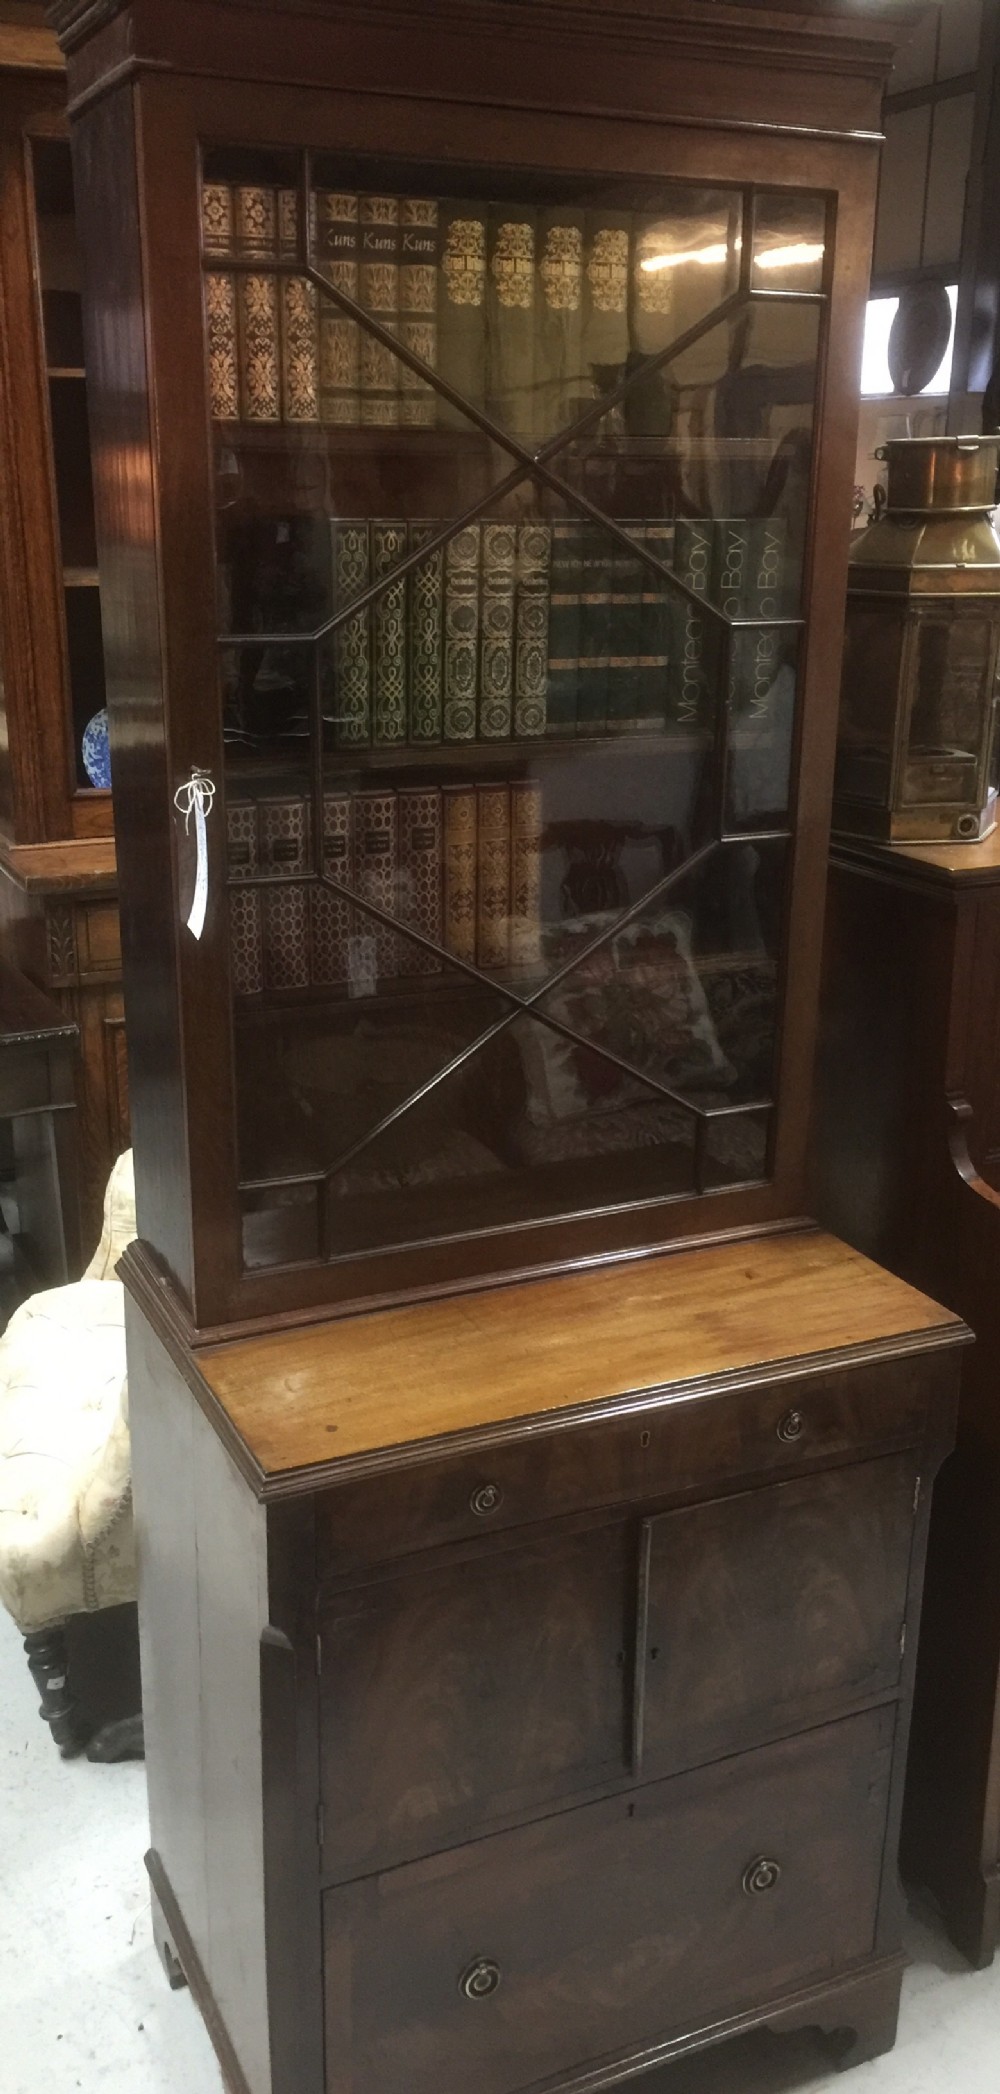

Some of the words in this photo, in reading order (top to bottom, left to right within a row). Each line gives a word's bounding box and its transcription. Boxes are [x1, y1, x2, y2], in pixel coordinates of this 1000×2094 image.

[362, 231, 397, 252] Kuns
[402, 233, 437, 253] Kuns
[685, 531, 712, 590] Bay
[720, 530, 748, 590] Bay
[757, 531, 782, 590] Bay
